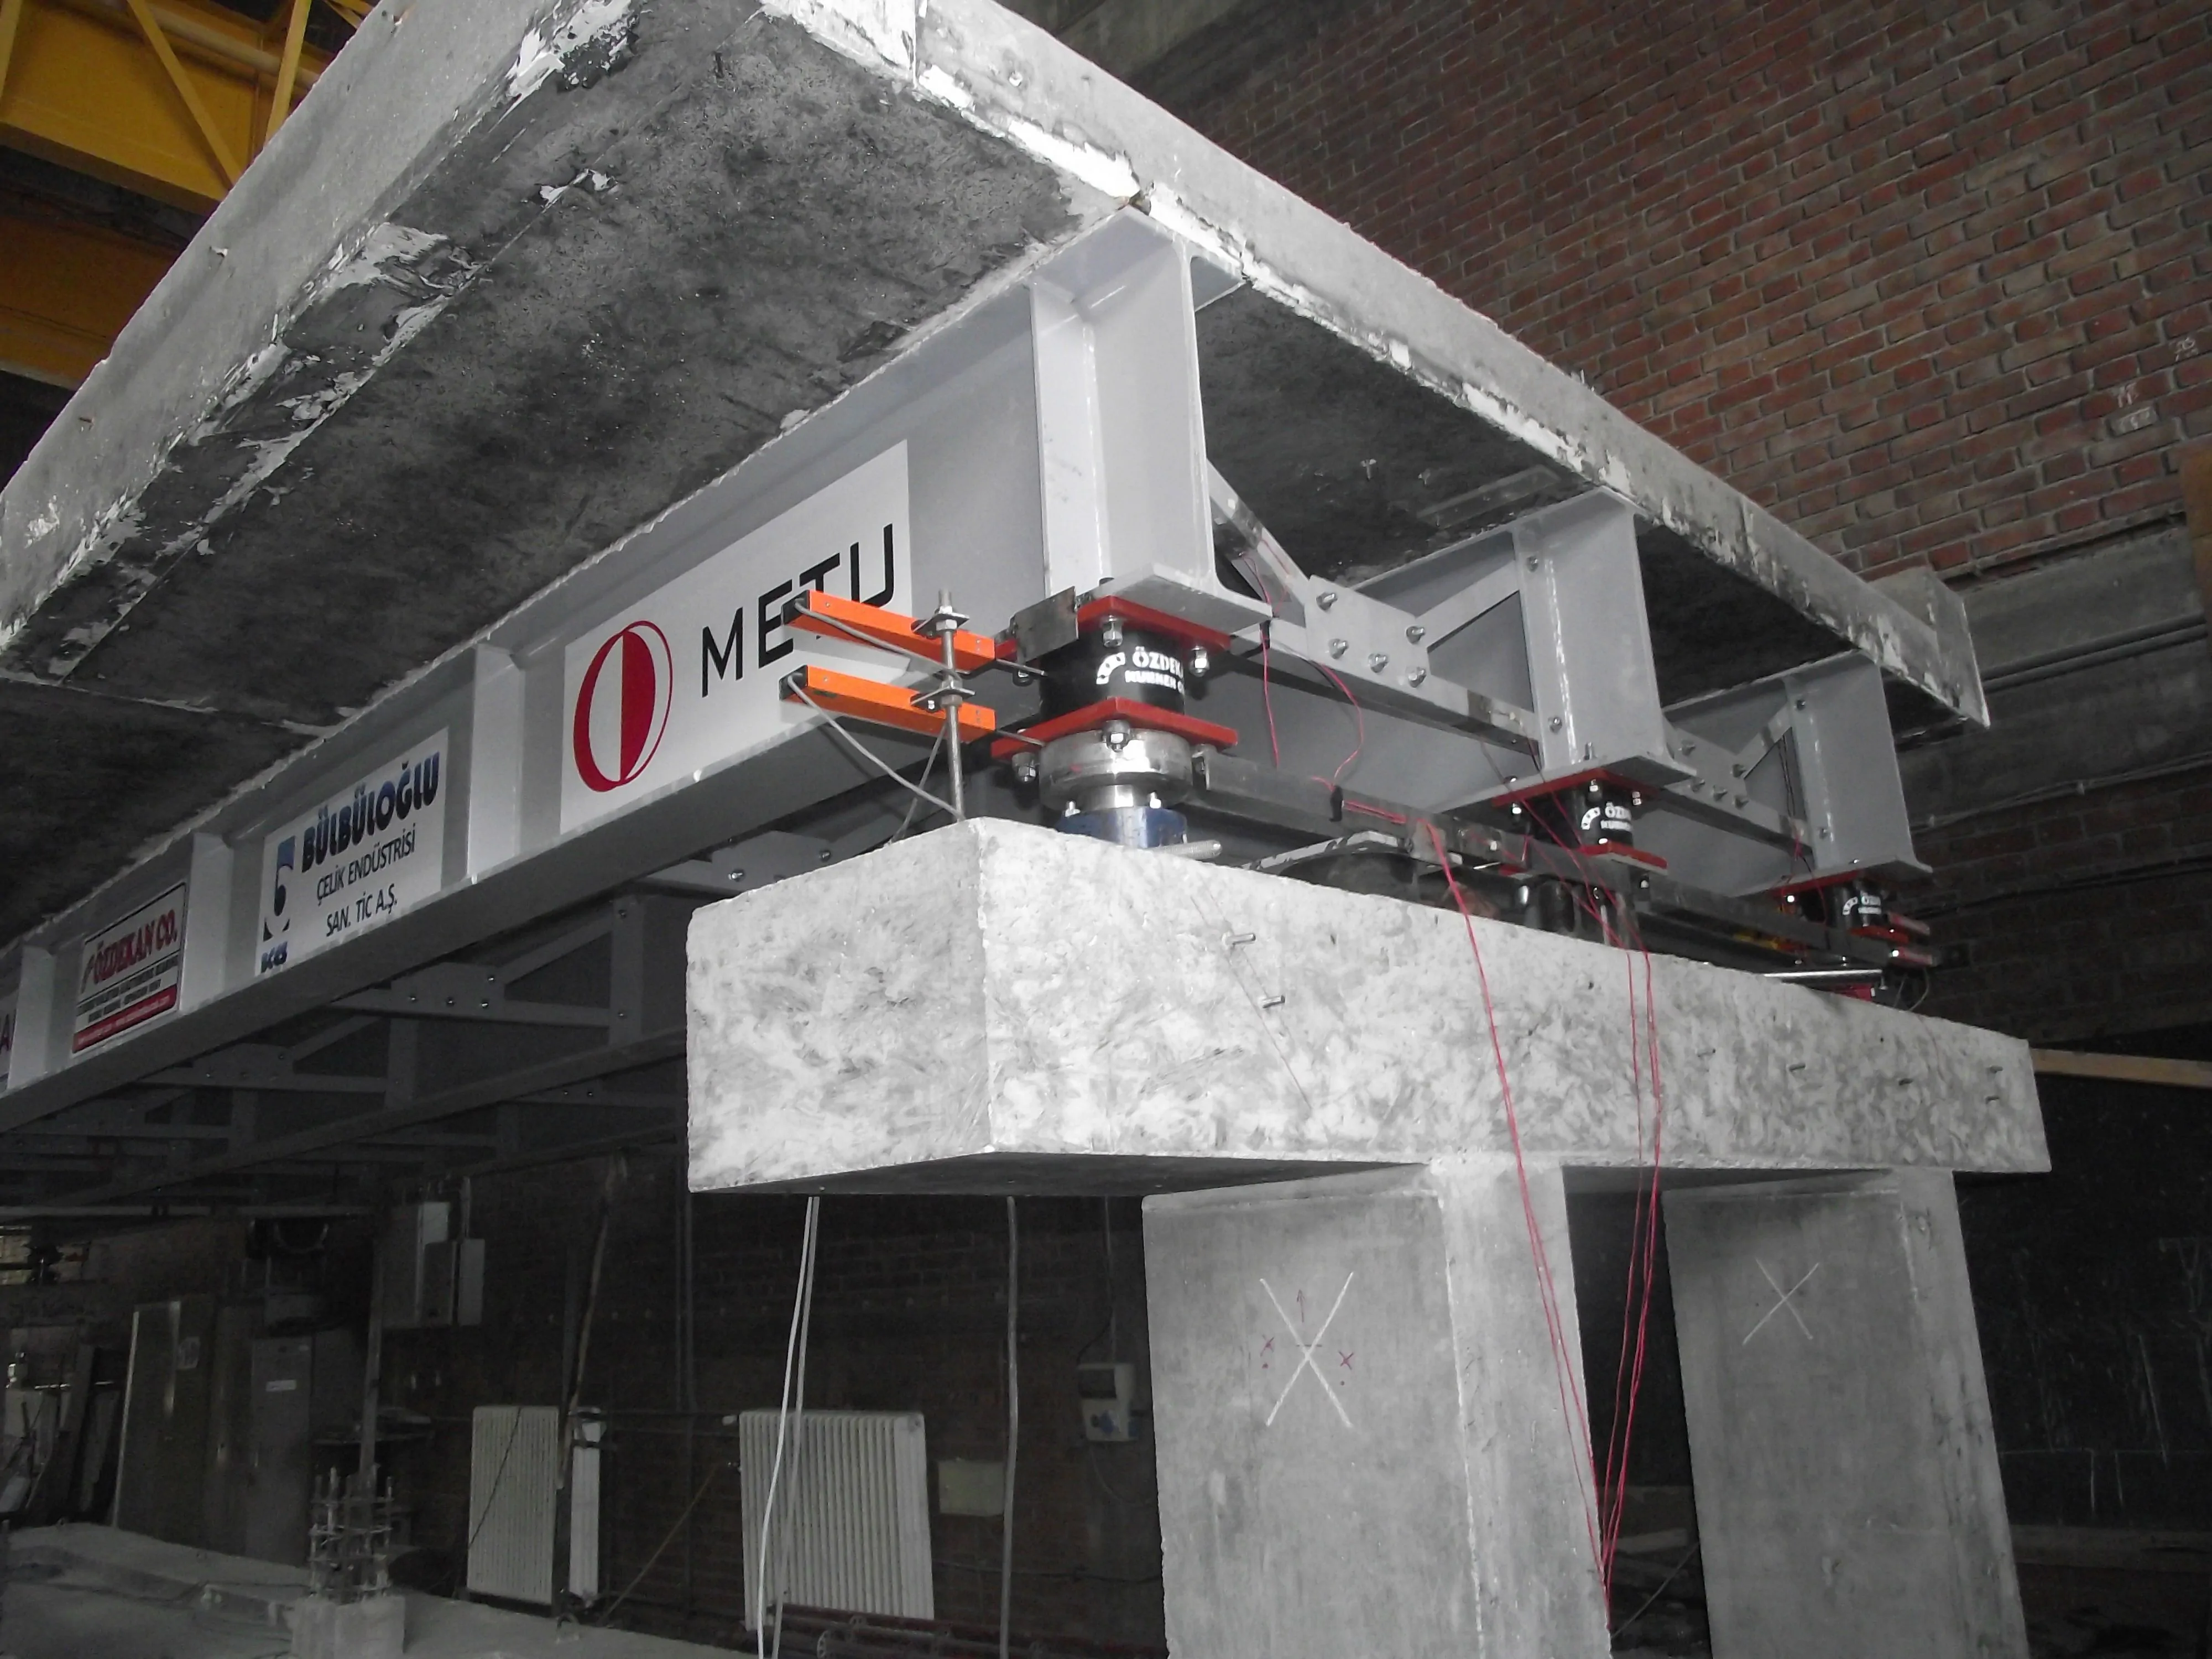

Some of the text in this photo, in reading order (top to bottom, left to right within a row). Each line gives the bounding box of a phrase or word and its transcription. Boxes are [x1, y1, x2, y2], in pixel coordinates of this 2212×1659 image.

[702, 523, 894, 697] METU
[301, 750, 440, 873] BÜLBÜLOĞLU
[316, 822, 416, 906] ÇELİK ENDÜSTRİSİ
[326, 907, 351, 937] SAN.
